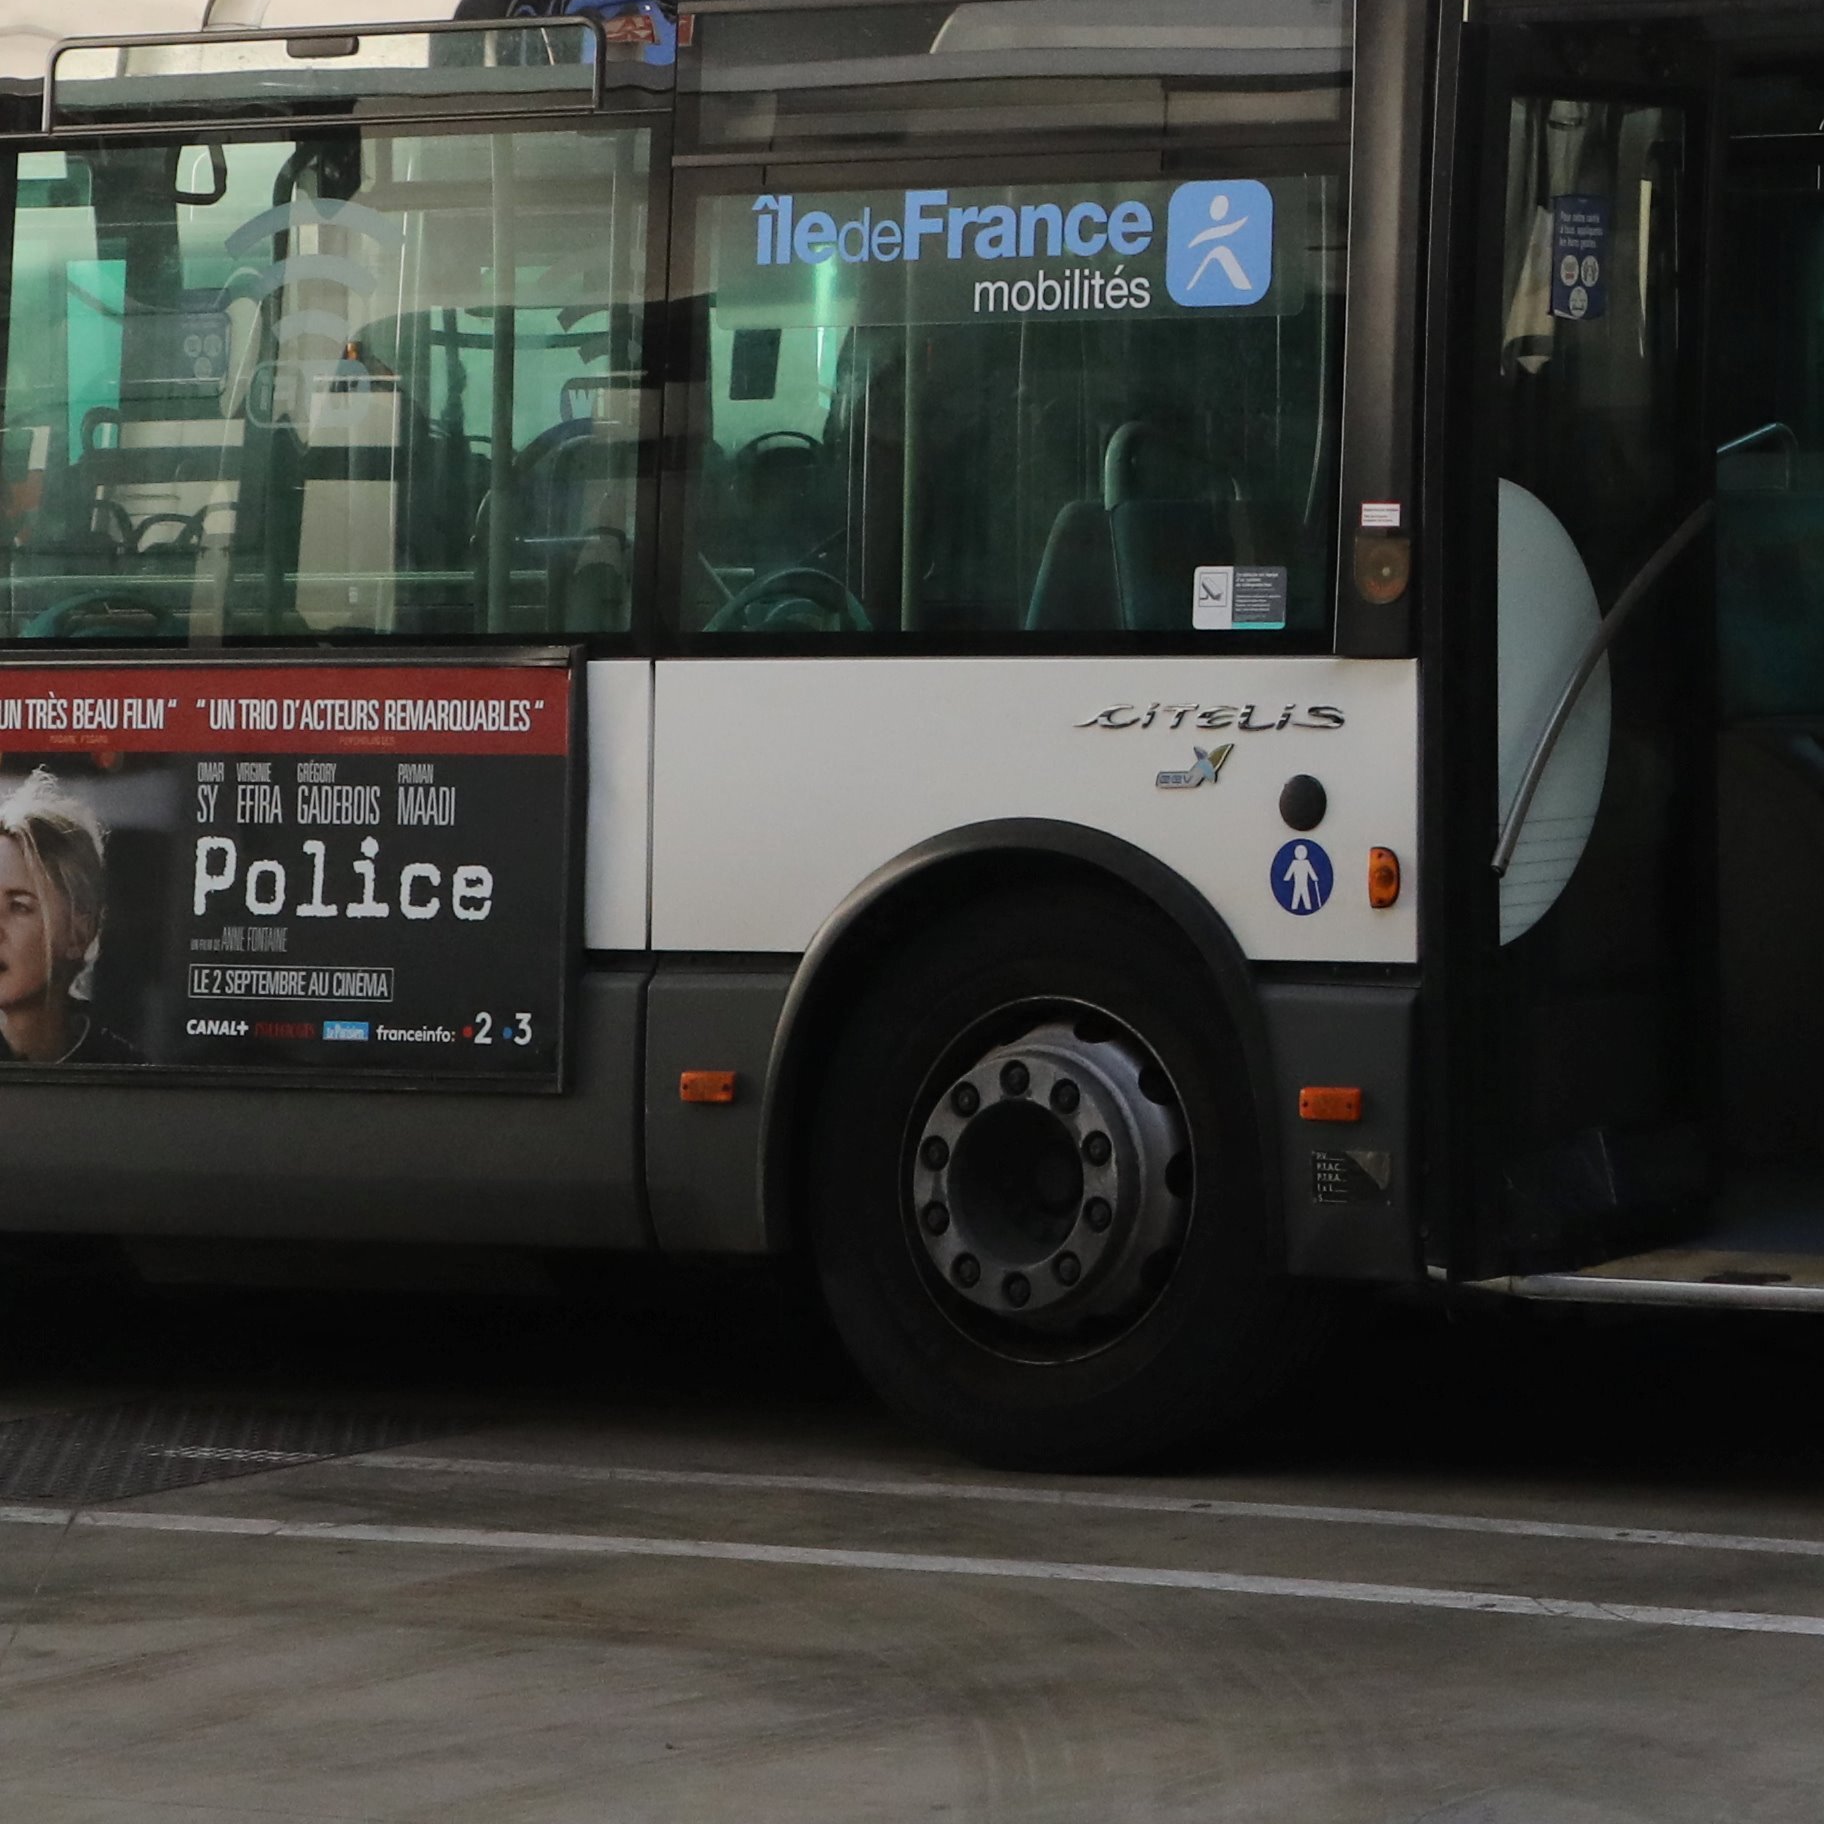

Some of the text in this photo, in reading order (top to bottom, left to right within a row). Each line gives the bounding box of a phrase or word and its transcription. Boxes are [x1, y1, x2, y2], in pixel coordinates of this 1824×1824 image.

[973, 265, 1152, 312] mobilités
[25, 691, 68, 730] TRÈS
[72, 698, 118, 730] BEAU
[123, 698, 164, 730] FILM
[210, 699, 236, 730] UN
[239, 698, 279, 730] TRIO
[283, 699, 379, 731] D'ACTEURS
[384, 699, 532, 732] REMARQUABLES
[198, 759, 434, 784] OMAR VIRGINIE GRÉGORY PAYMAN
[197, 784, 455, 826] SY EFIRA GADEBOIS MAADI
[194, 836, 494, 920] Police
[221, 927, 246, 952] ANNE
[246, 927, 288, 953] FONTAINE
[193, 968, 388, 997] LE 2 SEPTEMBRE AU CINÉMA
[187, 1019, 249, 1037] CANAL+
[376, 1025, 456, 1043] franceinfo:
[474, 1012, 492, 1044] 2
[514, 1012, 532, 1045] 3
